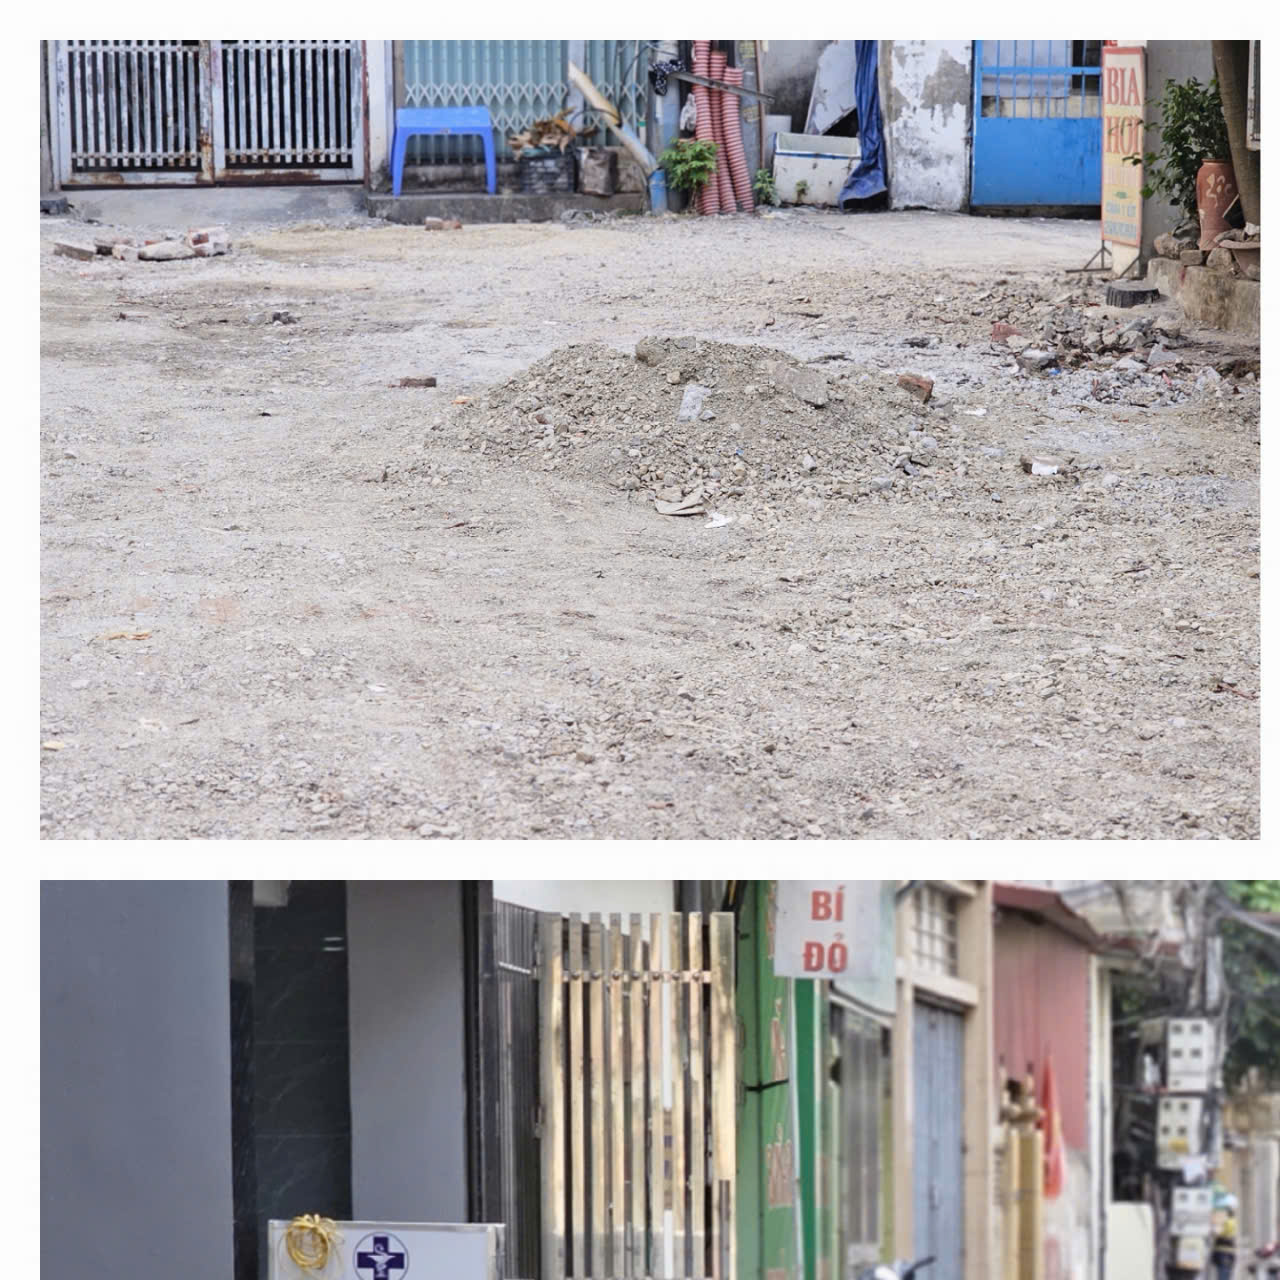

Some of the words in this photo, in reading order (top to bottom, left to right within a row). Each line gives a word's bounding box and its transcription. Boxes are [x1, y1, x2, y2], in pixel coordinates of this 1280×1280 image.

[1106, 67, 1140, 106] BIA
[811, 885, 845, 922] BÍ
[803, 932, 848, 973] ĐỎ
